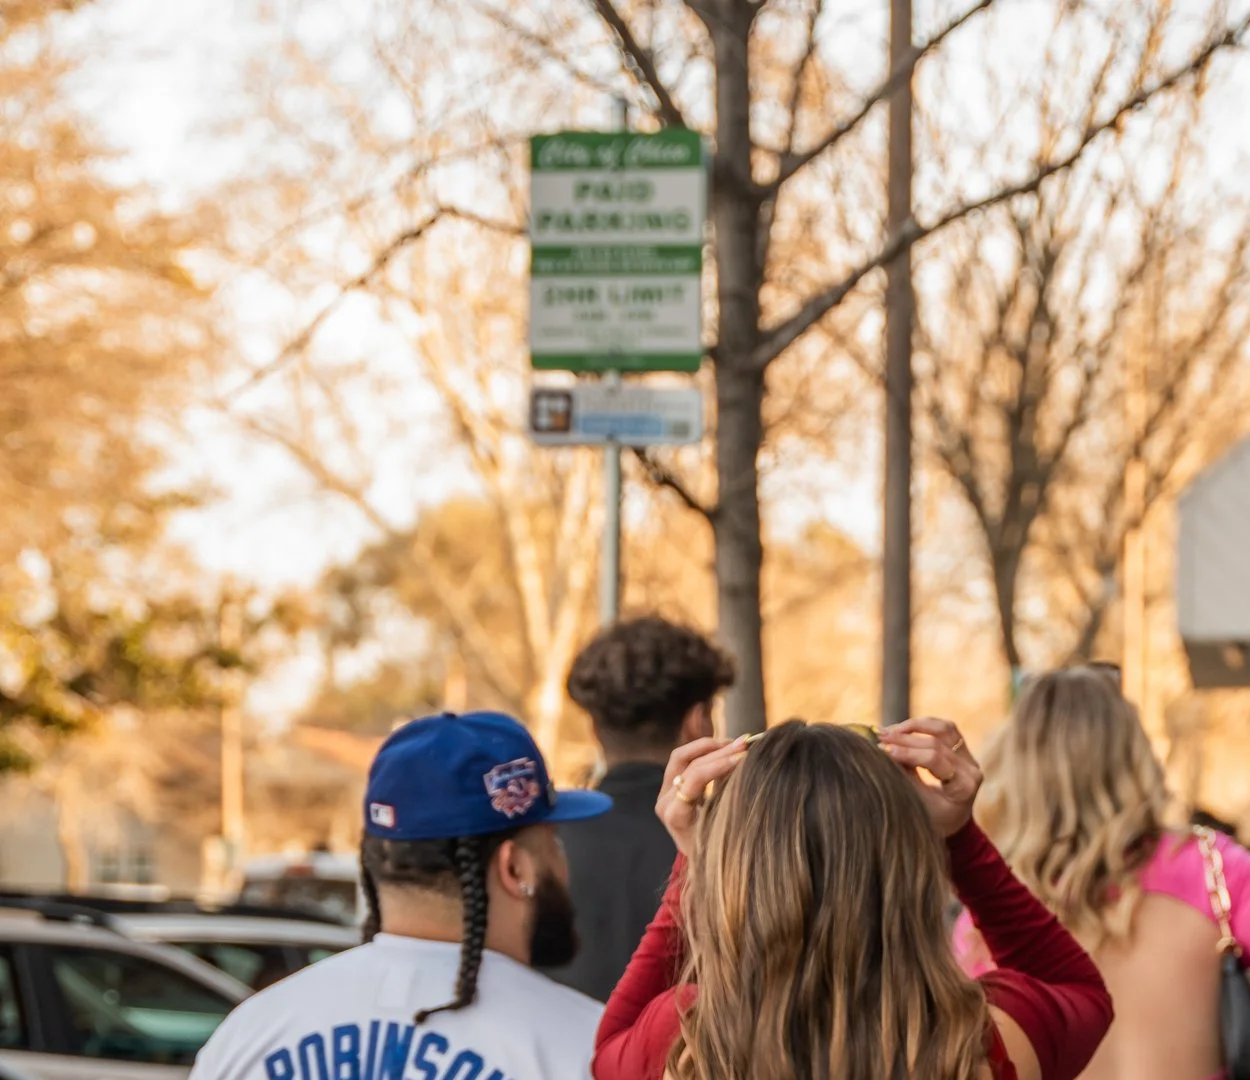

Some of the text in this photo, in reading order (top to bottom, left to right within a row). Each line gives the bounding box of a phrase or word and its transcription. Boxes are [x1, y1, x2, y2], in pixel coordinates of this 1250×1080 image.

[574, 180, 655, 202] PAID
[535, 209, 691, 232] PARKING
[607, 285, 685, 305] LIMIT
